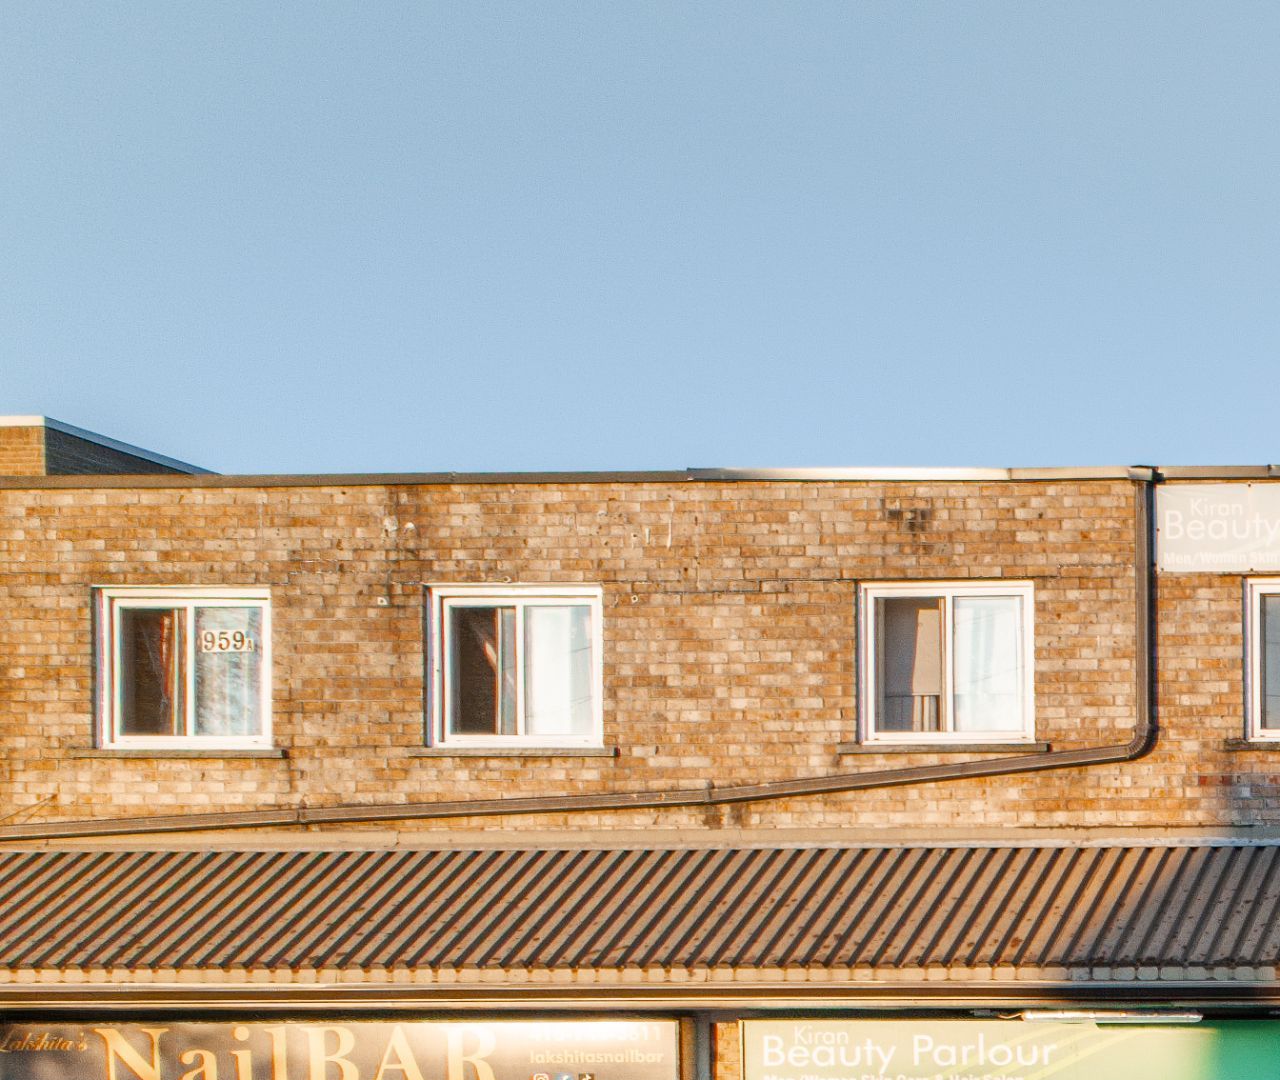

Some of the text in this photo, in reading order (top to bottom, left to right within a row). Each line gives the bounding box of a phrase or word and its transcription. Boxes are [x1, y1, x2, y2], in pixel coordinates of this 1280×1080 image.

[1191, 498, 1243, 516] Kiran
[1165, 510, 1280, 546] Beauty
[794, 1026, 849, 1045] Kiran
[762, 1033, 1058, 1074] Beauty Parlour
